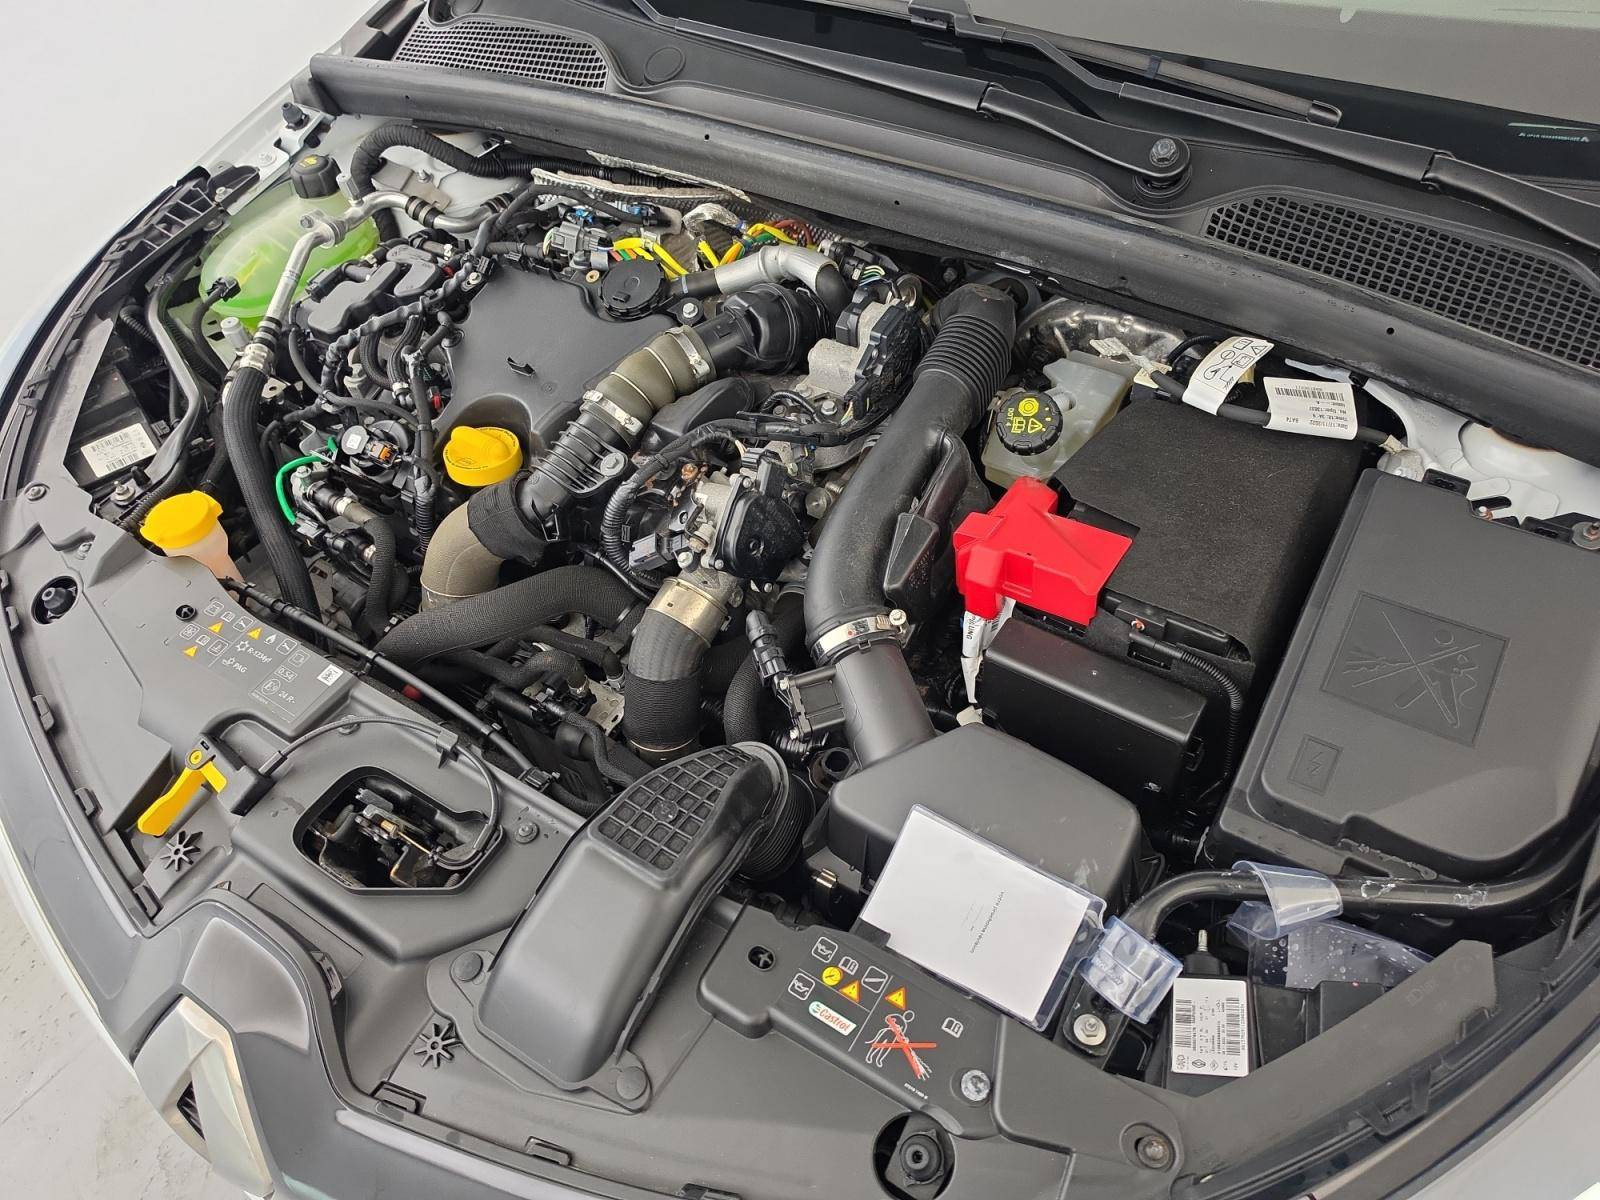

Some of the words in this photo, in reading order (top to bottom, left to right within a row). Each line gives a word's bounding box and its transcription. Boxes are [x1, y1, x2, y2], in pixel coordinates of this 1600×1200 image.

[1006, 407, 1015, 421] DOT
[233, 662, 247, 673] PAG
[819, 1009, 850, 1032] Castrol
